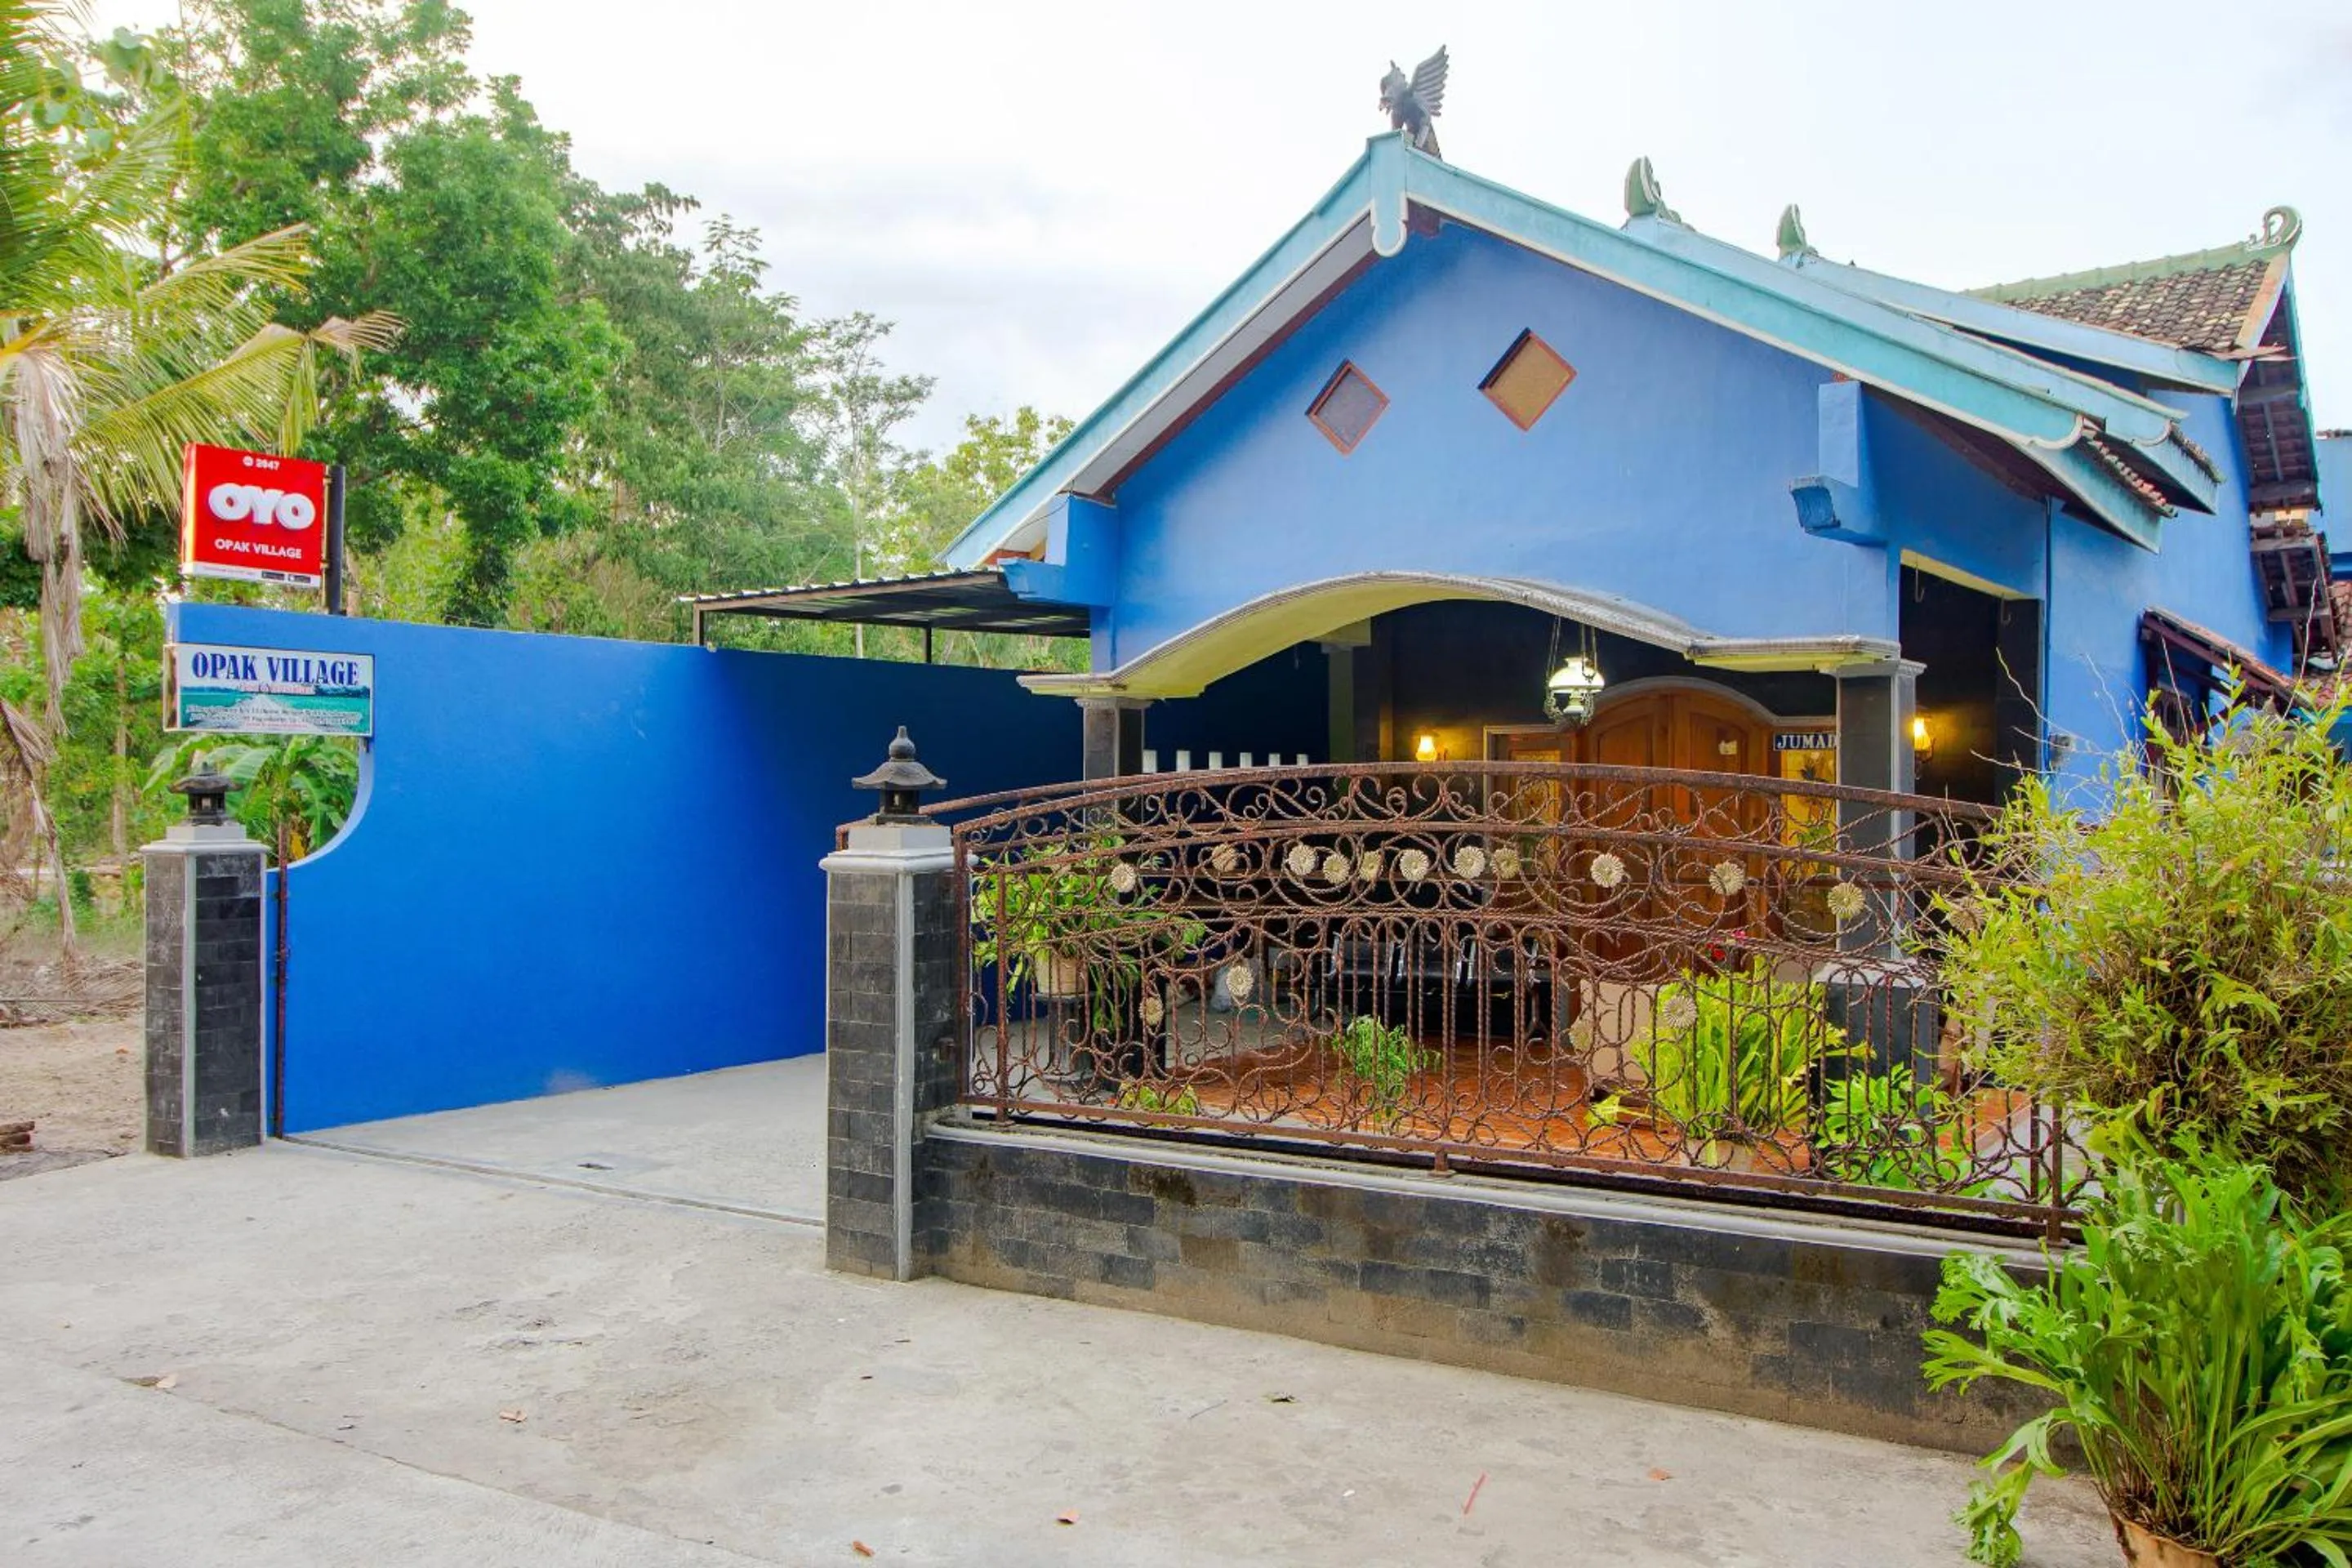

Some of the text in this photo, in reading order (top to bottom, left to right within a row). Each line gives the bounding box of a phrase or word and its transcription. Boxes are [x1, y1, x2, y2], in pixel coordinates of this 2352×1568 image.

[208, 483, 316, 530] OYO
[214, 538, 302, 559] OPAK VILLAGE
[191, 652, 359, 686] OPAK VILLAGE
